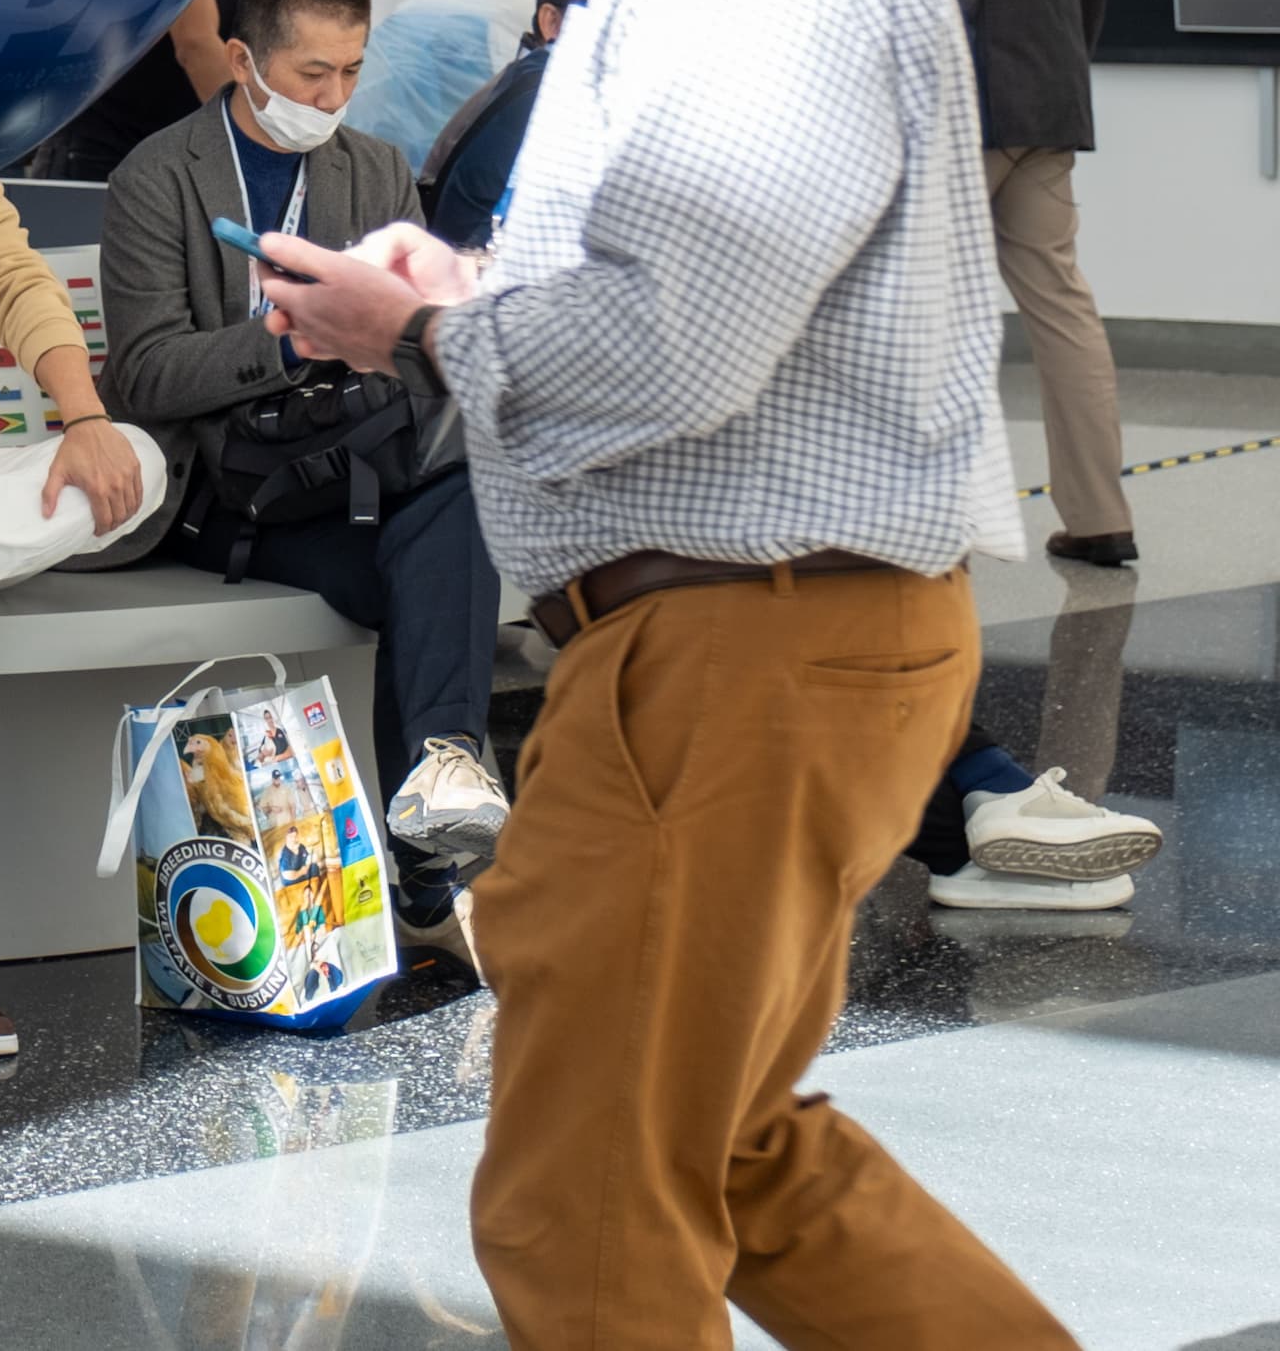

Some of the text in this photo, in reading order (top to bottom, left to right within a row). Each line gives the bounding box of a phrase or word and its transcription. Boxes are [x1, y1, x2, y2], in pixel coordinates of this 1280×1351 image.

[159, 843, 266, 887] BREEDING FOR
[157, 900, 205, 988] WELFARE
